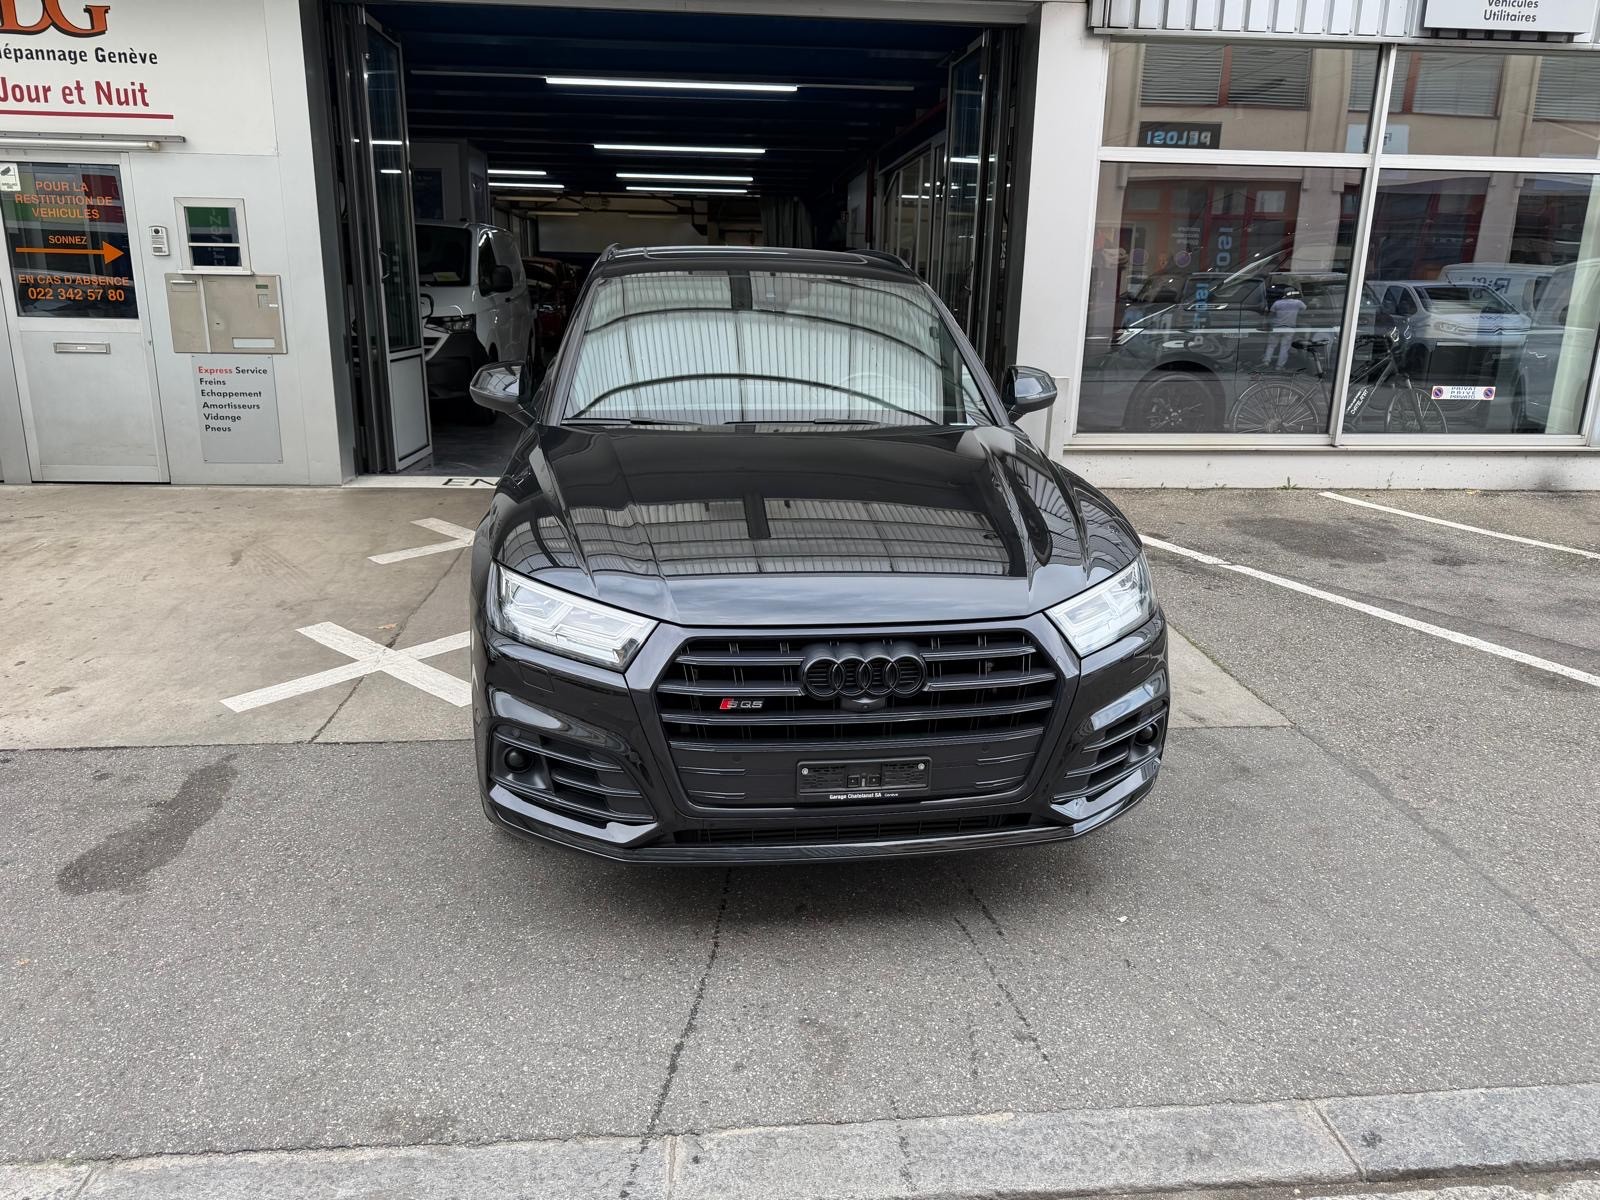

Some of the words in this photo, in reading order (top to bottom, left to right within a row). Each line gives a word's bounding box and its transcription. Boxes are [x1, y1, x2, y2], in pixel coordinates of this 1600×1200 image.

[1484, 9, 1537, 23] Utilitaires
[0, 43, 88, 65] épannage
[95, 46, 158, 65] Genève
[62, 80, 87, 105] et
[95, 81, 150, 107] Nuit
[35, 181, 70, 192] POUR
[73, 183, 89, 192] LA
[15, 193, 93, 206] RESTITUTION
[97, 196, 113, 206] DE
[31, 207, 101, 219] VEHICULES
[48, 235, 88, 245] SONNEZ
[18, 274, 34, 284] EN
[37, 275, 61, 285] CAS
[64, 276, 129, 286] D'ABSENCE
[28, 287, 54, 300] 022
[57, 288, 83, 301] 342
[87, 289, 103, 301] 57
[107, 289, 125, 301] 80
[198, 366, 233, 375] Express
[235, 366, 268, 375] Service
[199, 378, 226, 386] Freins
[201, 389, 262, 399] Echappement
[202, 401, 261, 410] Amortisseurs
[203, 413, 242, 423] Vidange
[204, 424, 232, 432] Pneus
